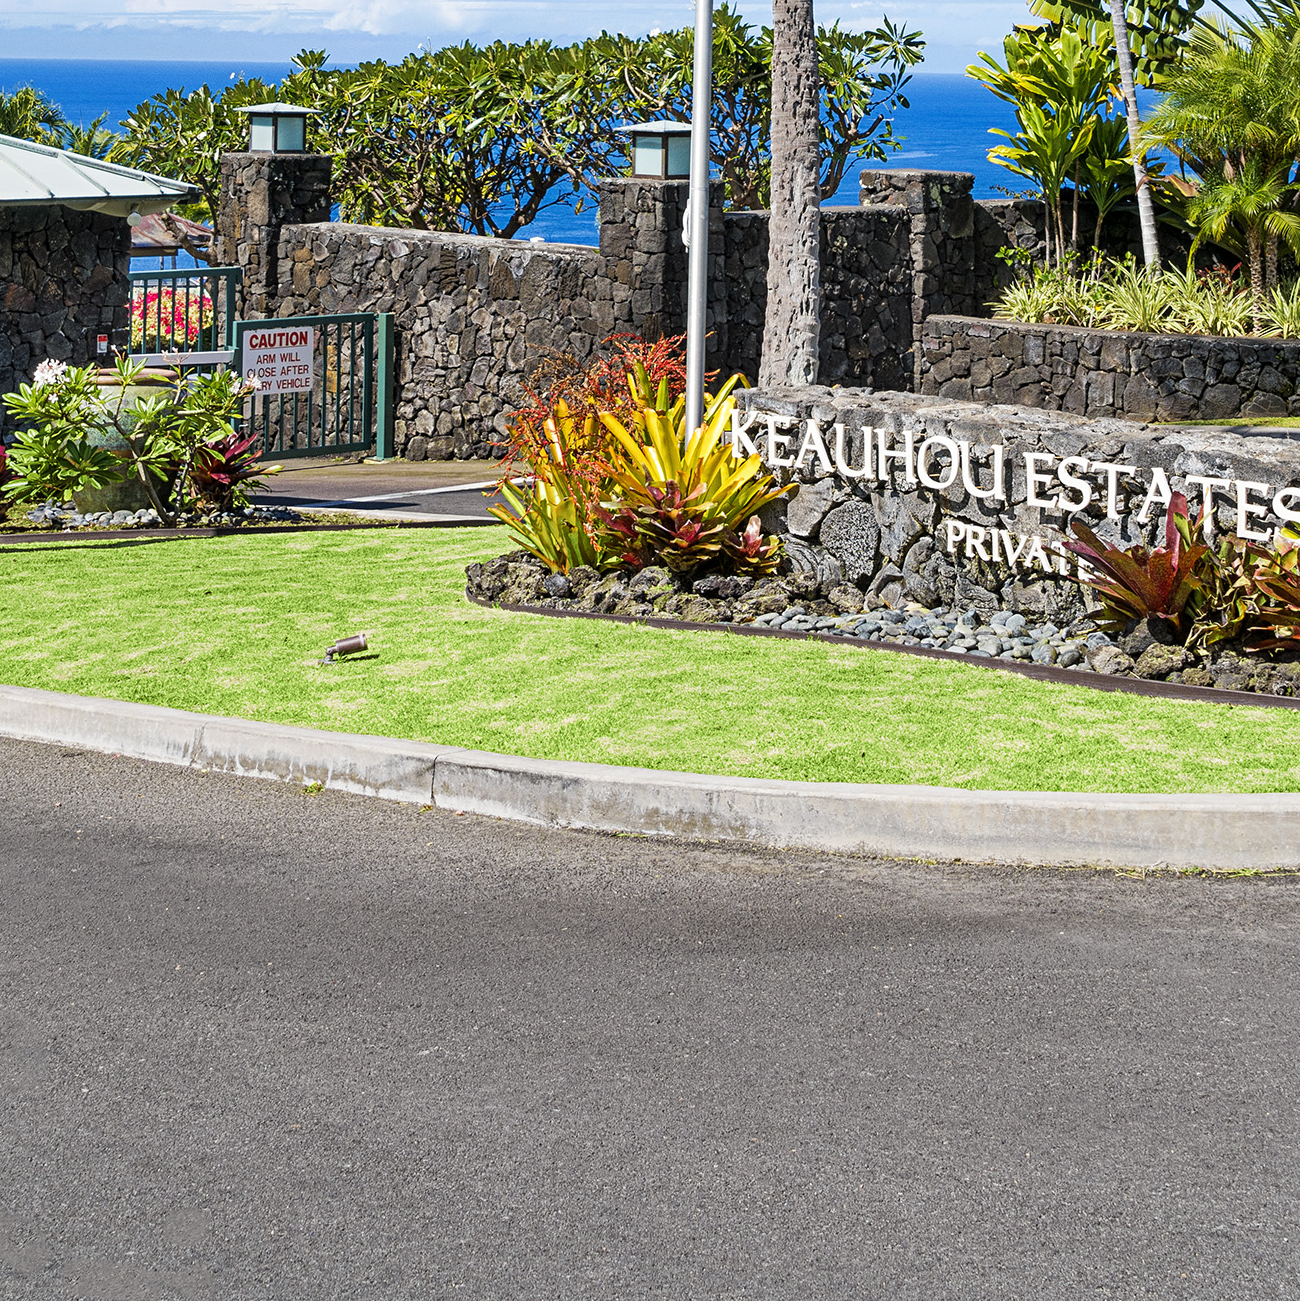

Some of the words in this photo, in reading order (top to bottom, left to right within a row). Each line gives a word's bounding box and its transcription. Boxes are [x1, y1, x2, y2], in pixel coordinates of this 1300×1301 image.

[249, 331, 308, 348] CAUTION
[256, 353, 276, 364] ARM
[280, 352, 300, 362] WILL
[280, 364, 309, 376] AFTER
[276, 377, 310, 390] VEHICLE
[730, 408, 1008, 502] KEAUHOU
